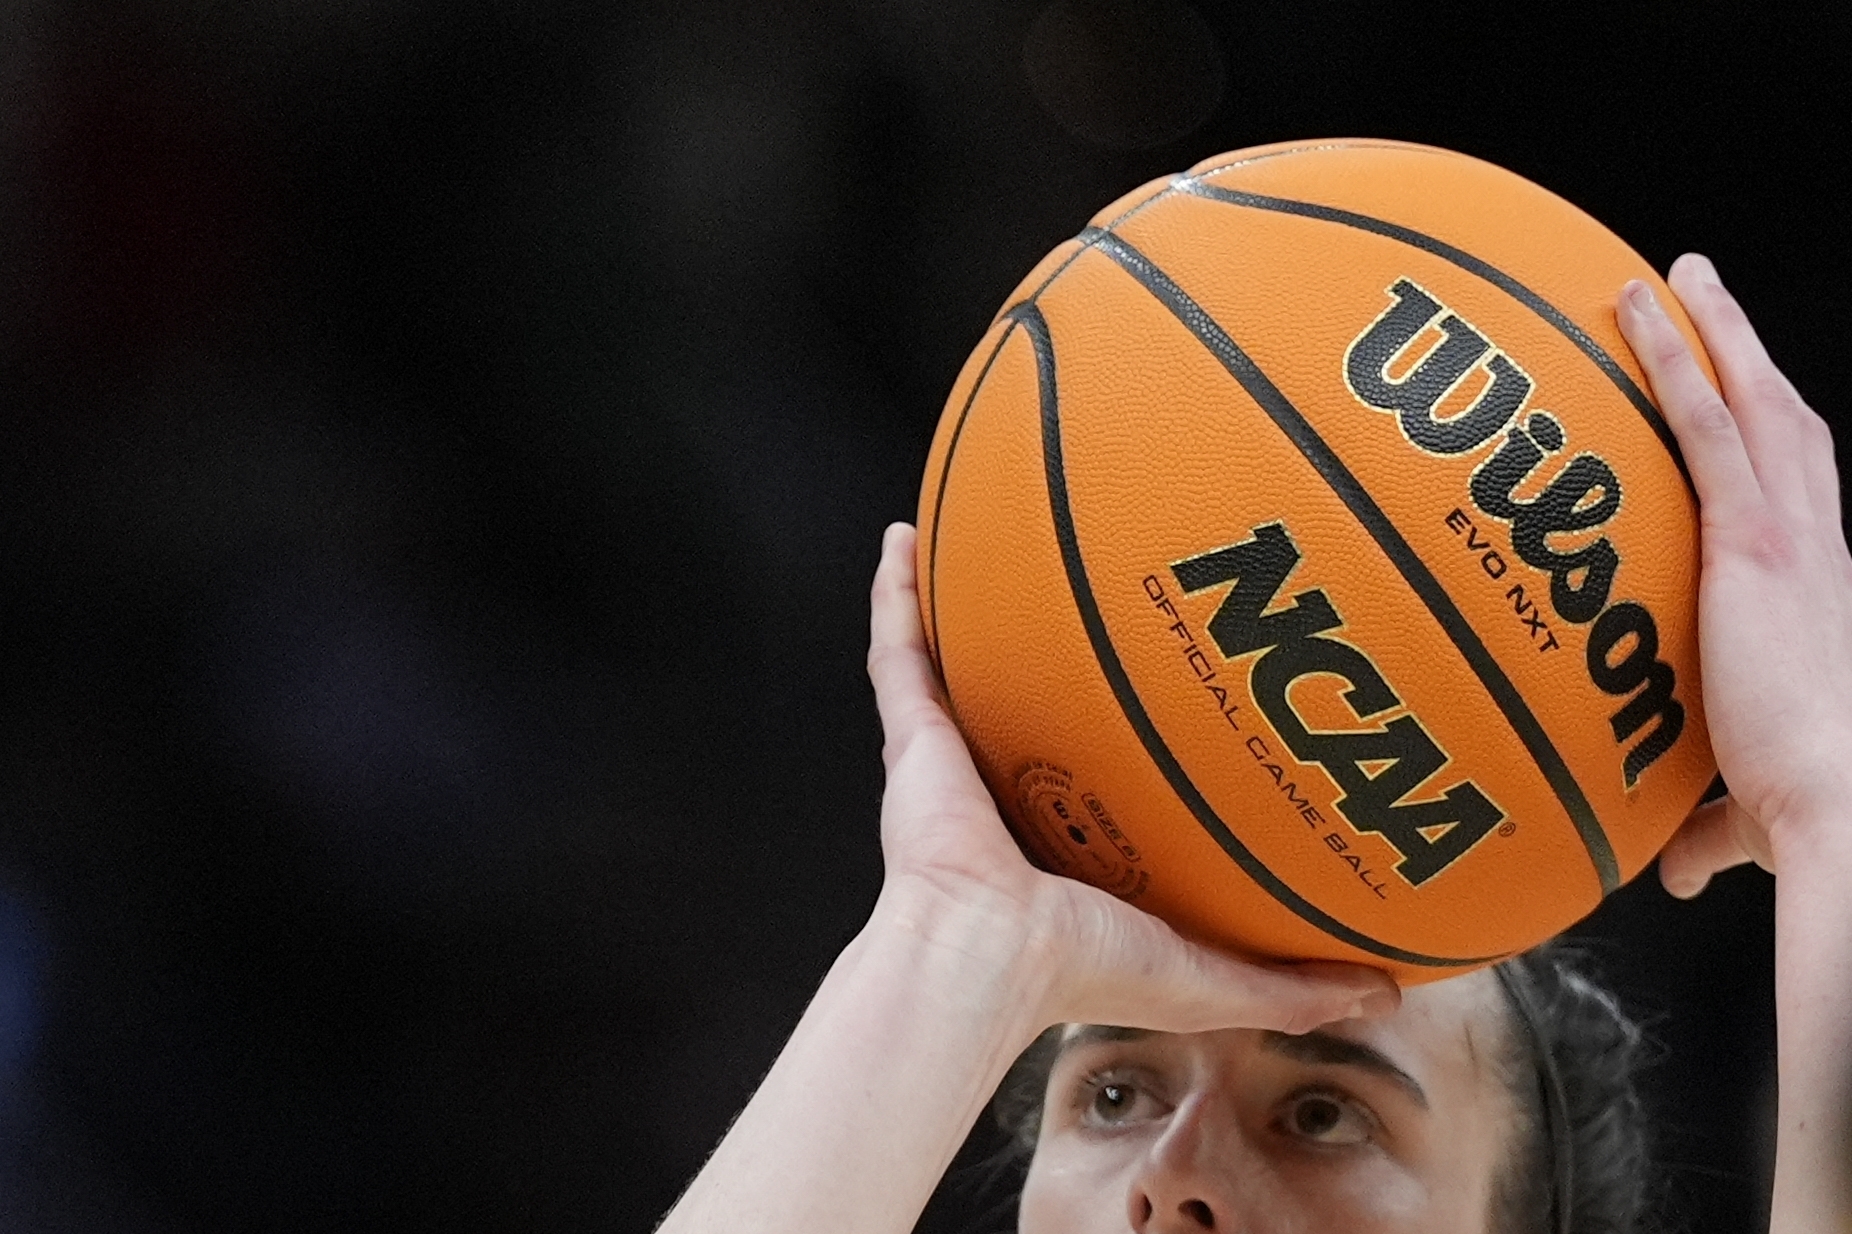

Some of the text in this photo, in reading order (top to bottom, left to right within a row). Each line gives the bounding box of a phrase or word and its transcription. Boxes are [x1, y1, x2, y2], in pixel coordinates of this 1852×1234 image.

[1168, 519, 1510, 889] NCAA
[1342, 276, 1685, 791] Wilson
[1444, 508, 1560, 653] EVO NXT
[1142, 574, 1388, 900] OFFICIAL GAME BALL
